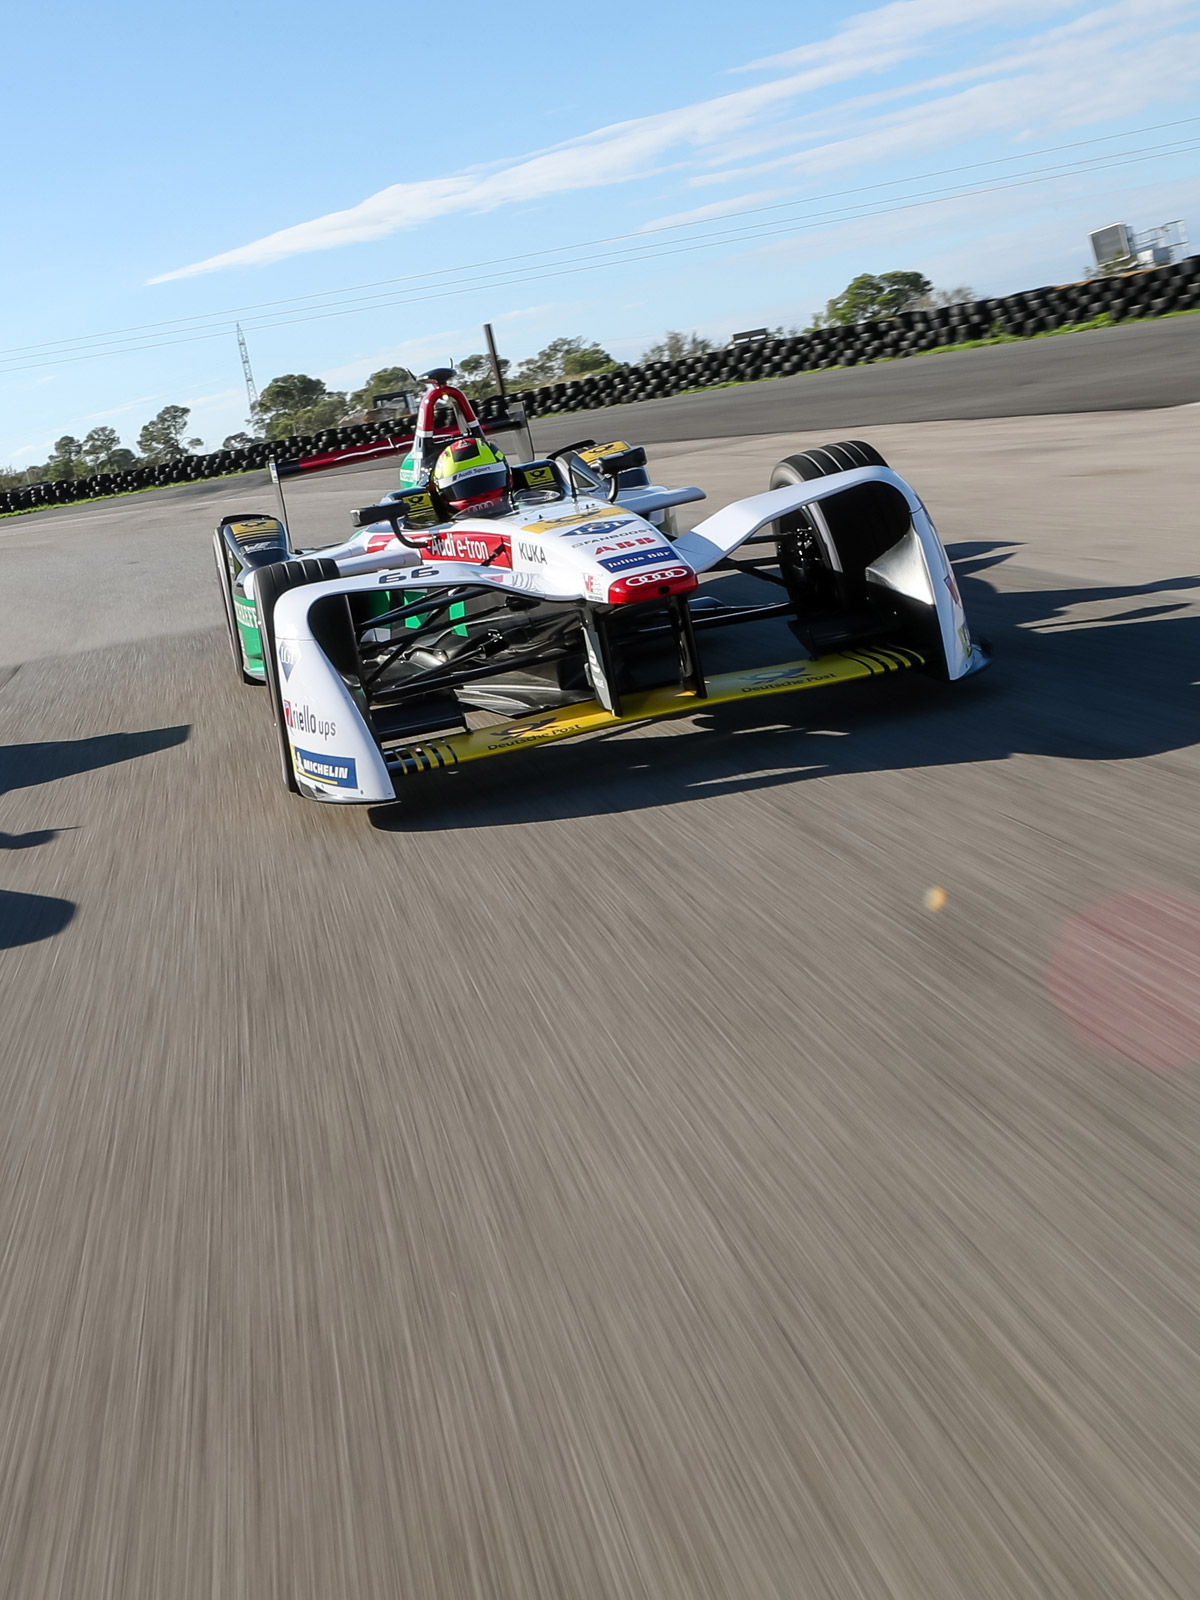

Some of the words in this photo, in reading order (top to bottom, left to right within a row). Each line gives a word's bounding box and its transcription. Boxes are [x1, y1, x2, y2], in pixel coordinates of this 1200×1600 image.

[458, 469, 472, 478] Audi
[473, 466, 490, 474] Sport
[431, 533, 456, 557] Audi
[456, 538, 490, 560] e-tron
[583, 528, 653, 545] FANBOOST
[595, 537, 656, 555] ABB
[518, 542, 548, 565] KUKA
[608, 556, 645, 568] Julius
[378, 566, 439, 584] 66
[741, 680, 804, 693] Deutsche
[806, 673, 837, 682] Post
[293, 703, 317, 734] riello
[318, 720, 336, 741] ups
[488, 733, 549, 750] Deutsche
[552, 724, 581, 735] Post
[303, 758, 349, 779] MICHELIN
